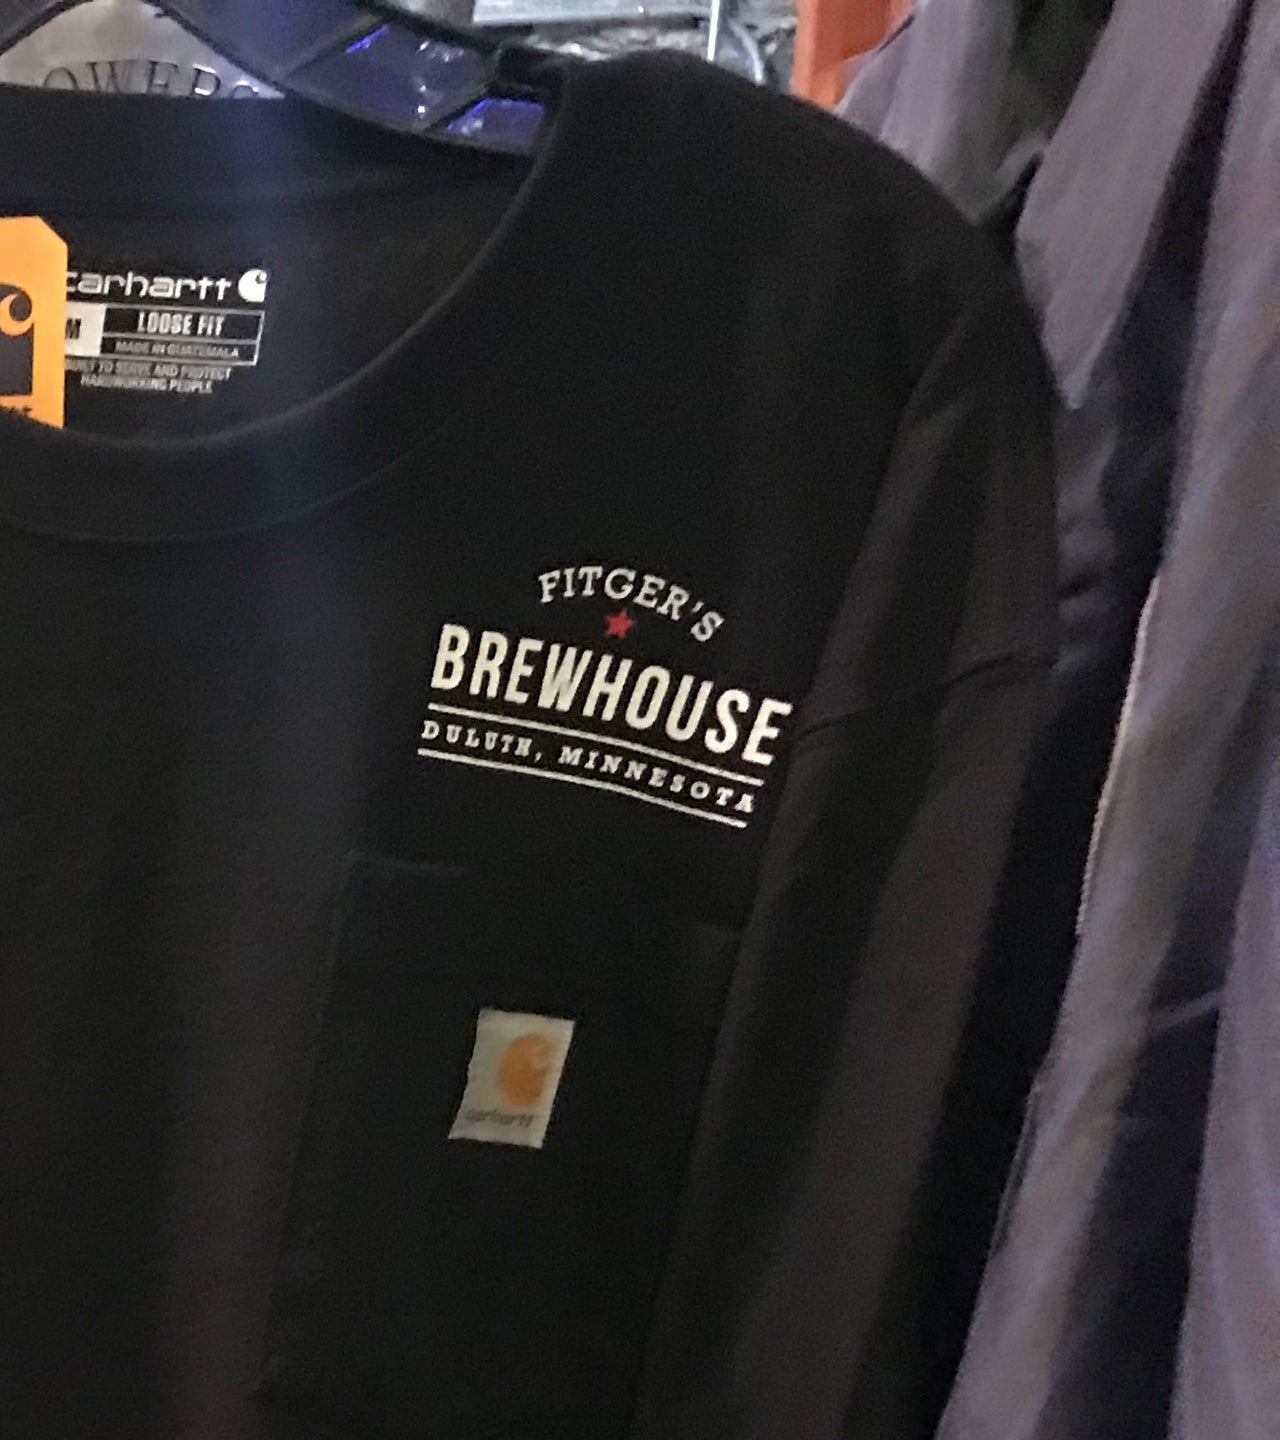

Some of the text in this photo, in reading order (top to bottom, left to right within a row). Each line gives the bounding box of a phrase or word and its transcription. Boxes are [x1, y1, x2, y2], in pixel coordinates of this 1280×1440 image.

[66, 271, 232, 301] carhartt
[137, 311, 226, 337] LOOSE FIT
[538, 565, 725, 643] FITGER'S
[430, 622, 793, 767] BREWHOUSE
[421, 719, 755, 814] DULUTH, MINNESOTA
